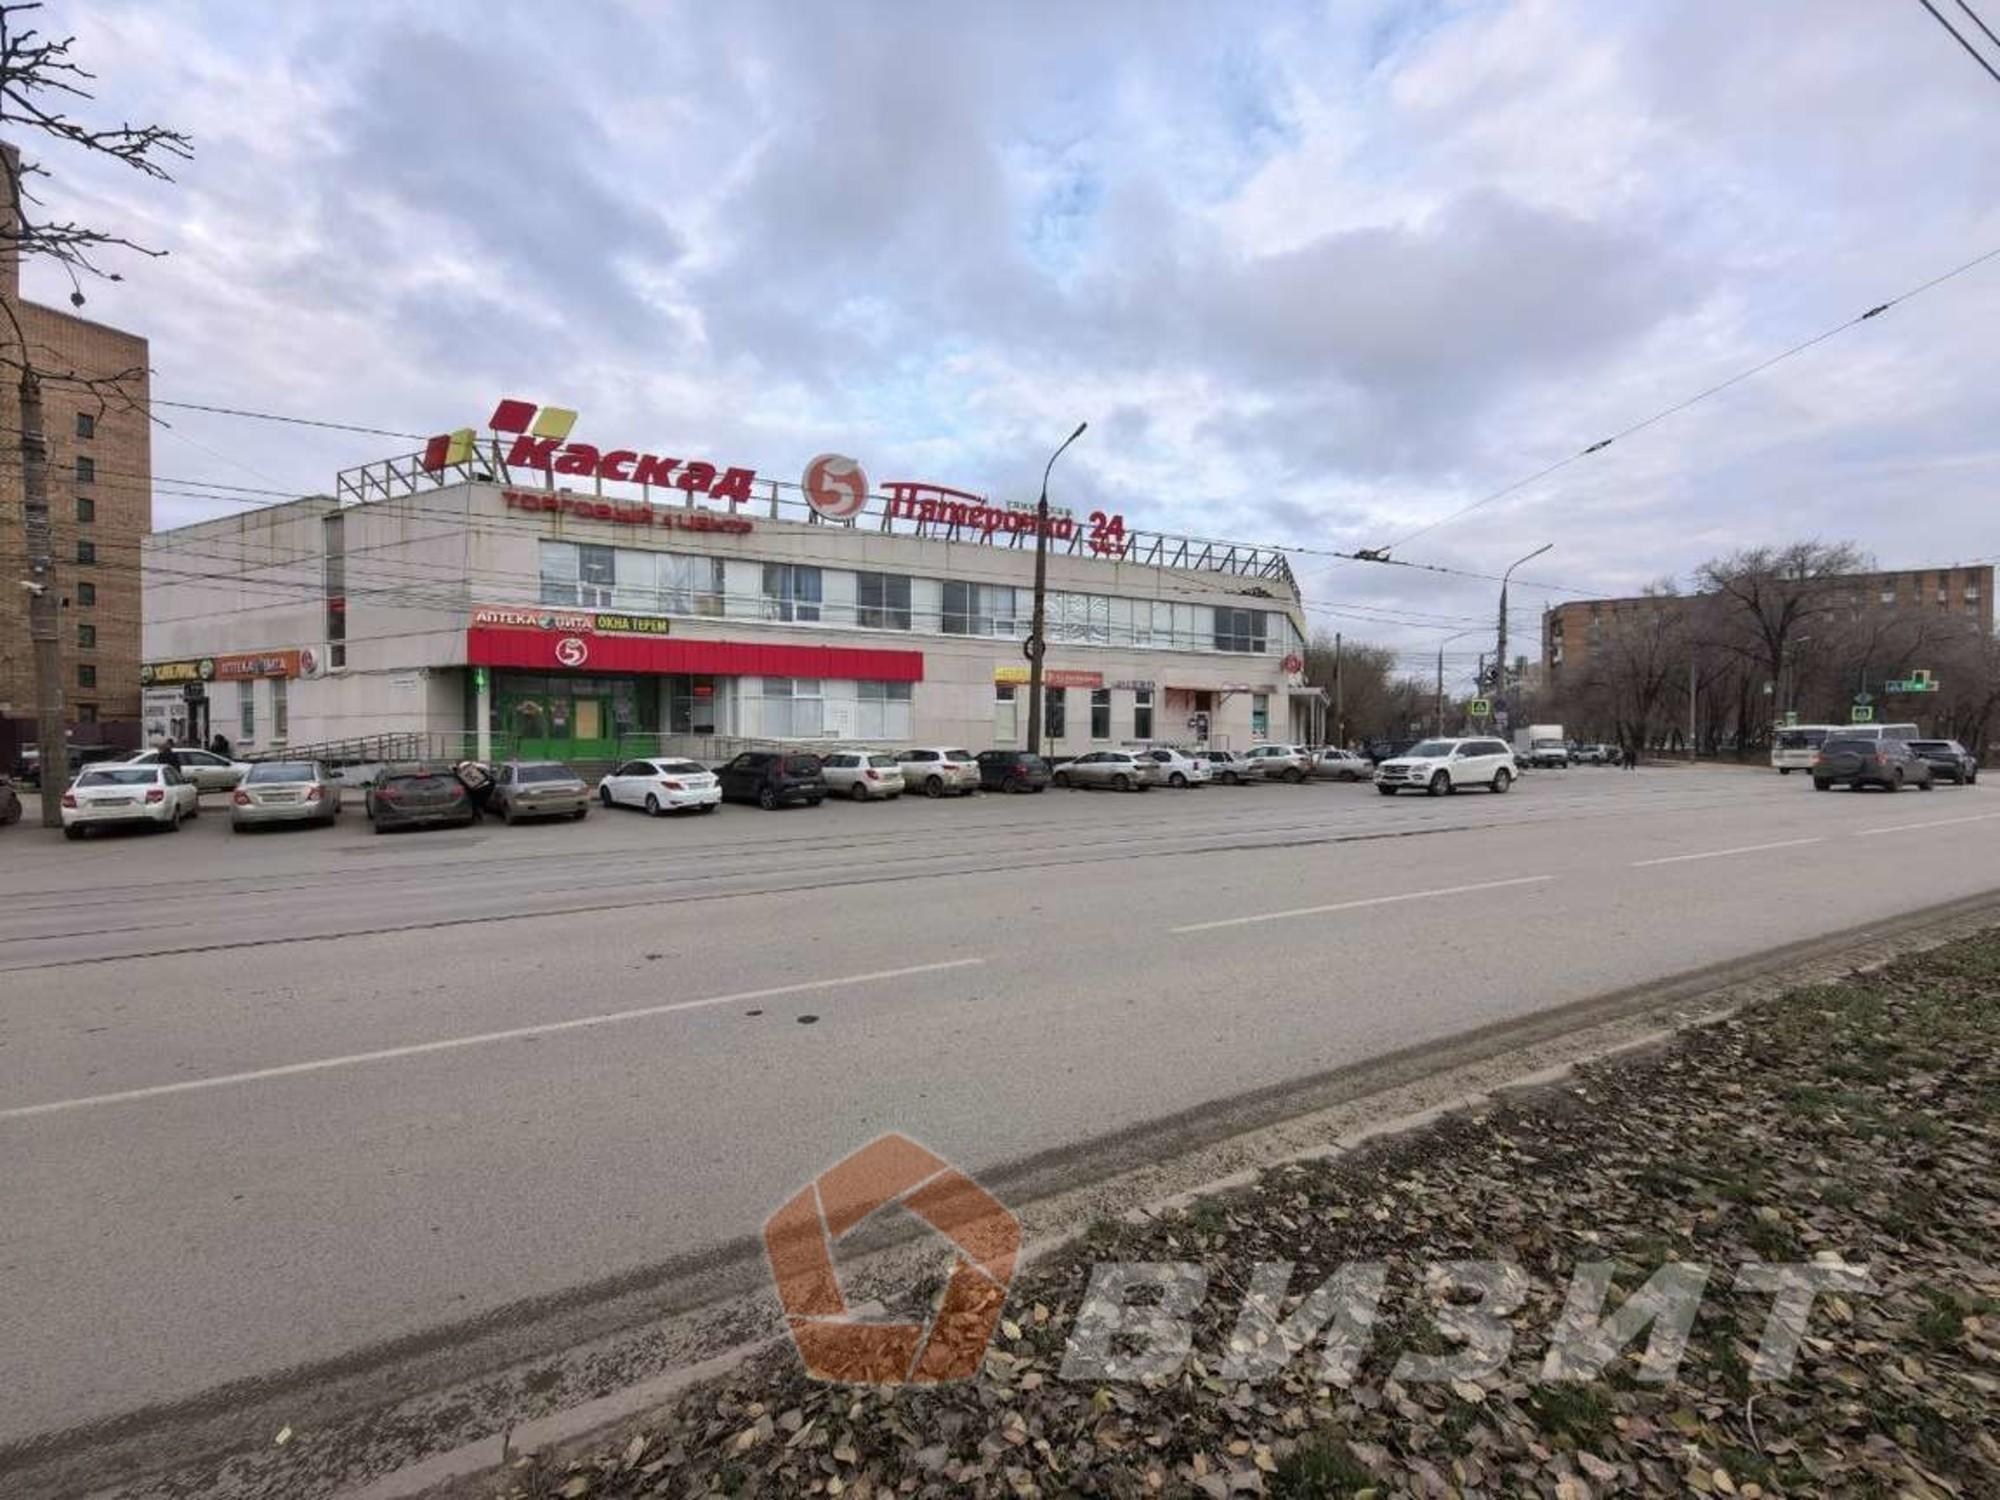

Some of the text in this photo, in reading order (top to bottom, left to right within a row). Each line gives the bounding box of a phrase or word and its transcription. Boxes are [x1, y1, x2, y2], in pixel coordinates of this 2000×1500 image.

[1089, 511, 1125, 542] 24
[475, 610, 539, 626] АПТЕКА
[597, 616, 668, 633] ОКНА ТЕРЕМ
